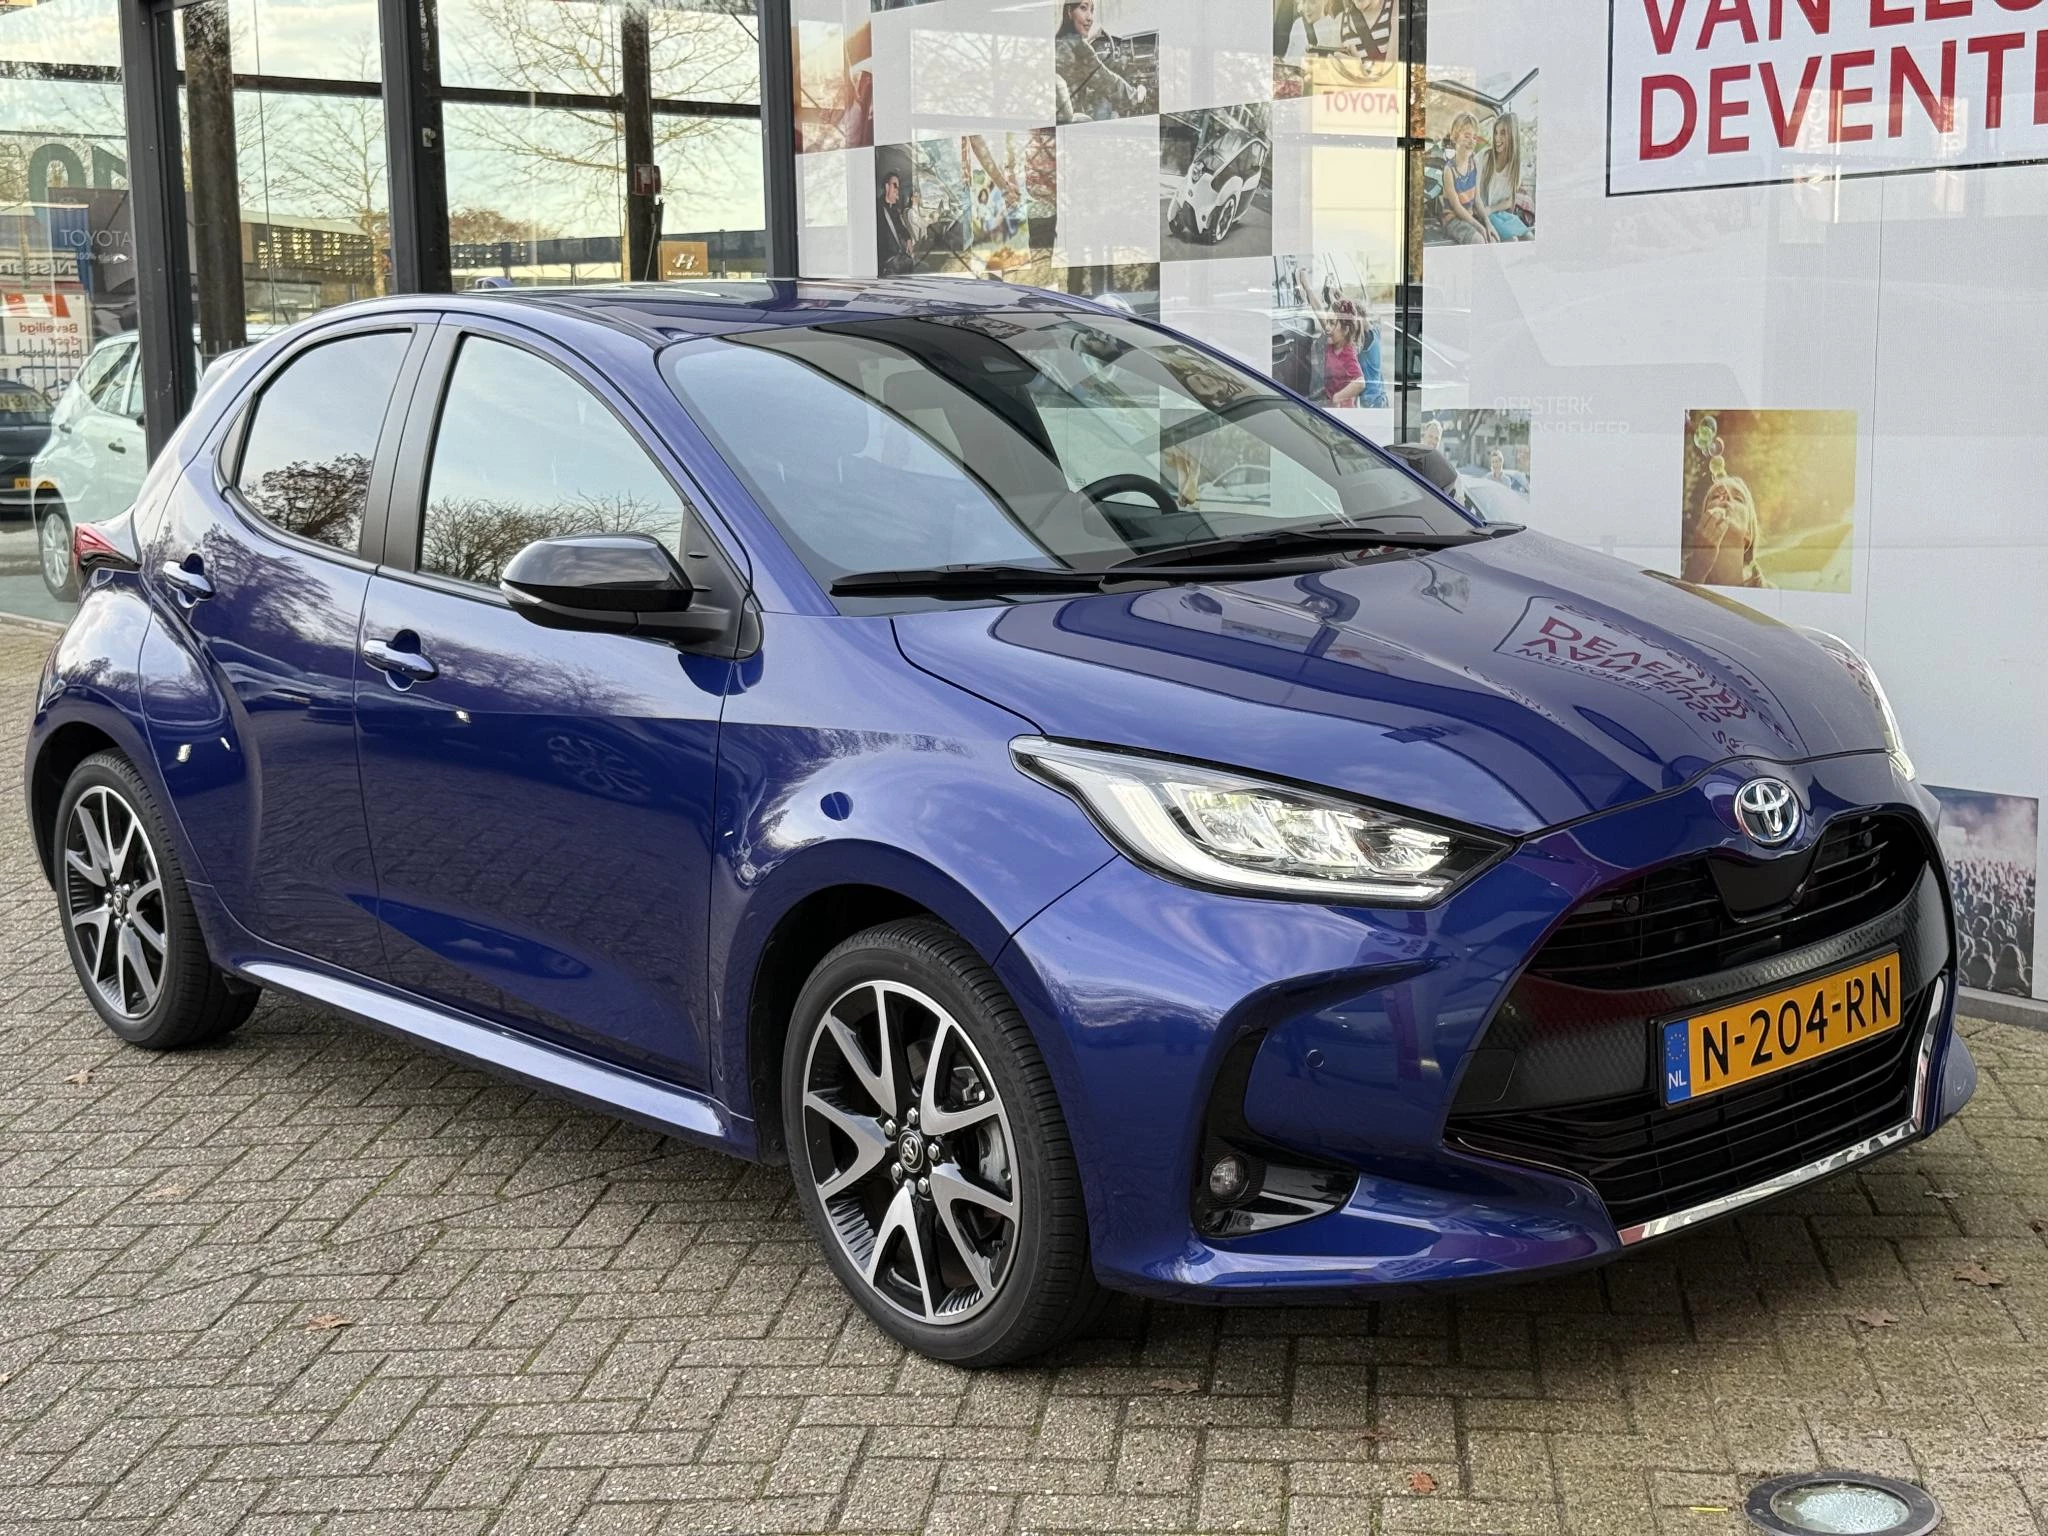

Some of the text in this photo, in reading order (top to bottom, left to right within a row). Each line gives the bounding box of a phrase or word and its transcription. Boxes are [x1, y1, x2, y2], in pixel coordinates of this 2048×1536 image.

[1322, 90, 1399, 114] TOYOTA
[1638, 29, 2048, 161] DEVENT
[60, 229, 132, 247] TOYOTA
[1703, 967, 1891, 1081] N-204-RN
[1668, 1070, 1687, 1089] NL
